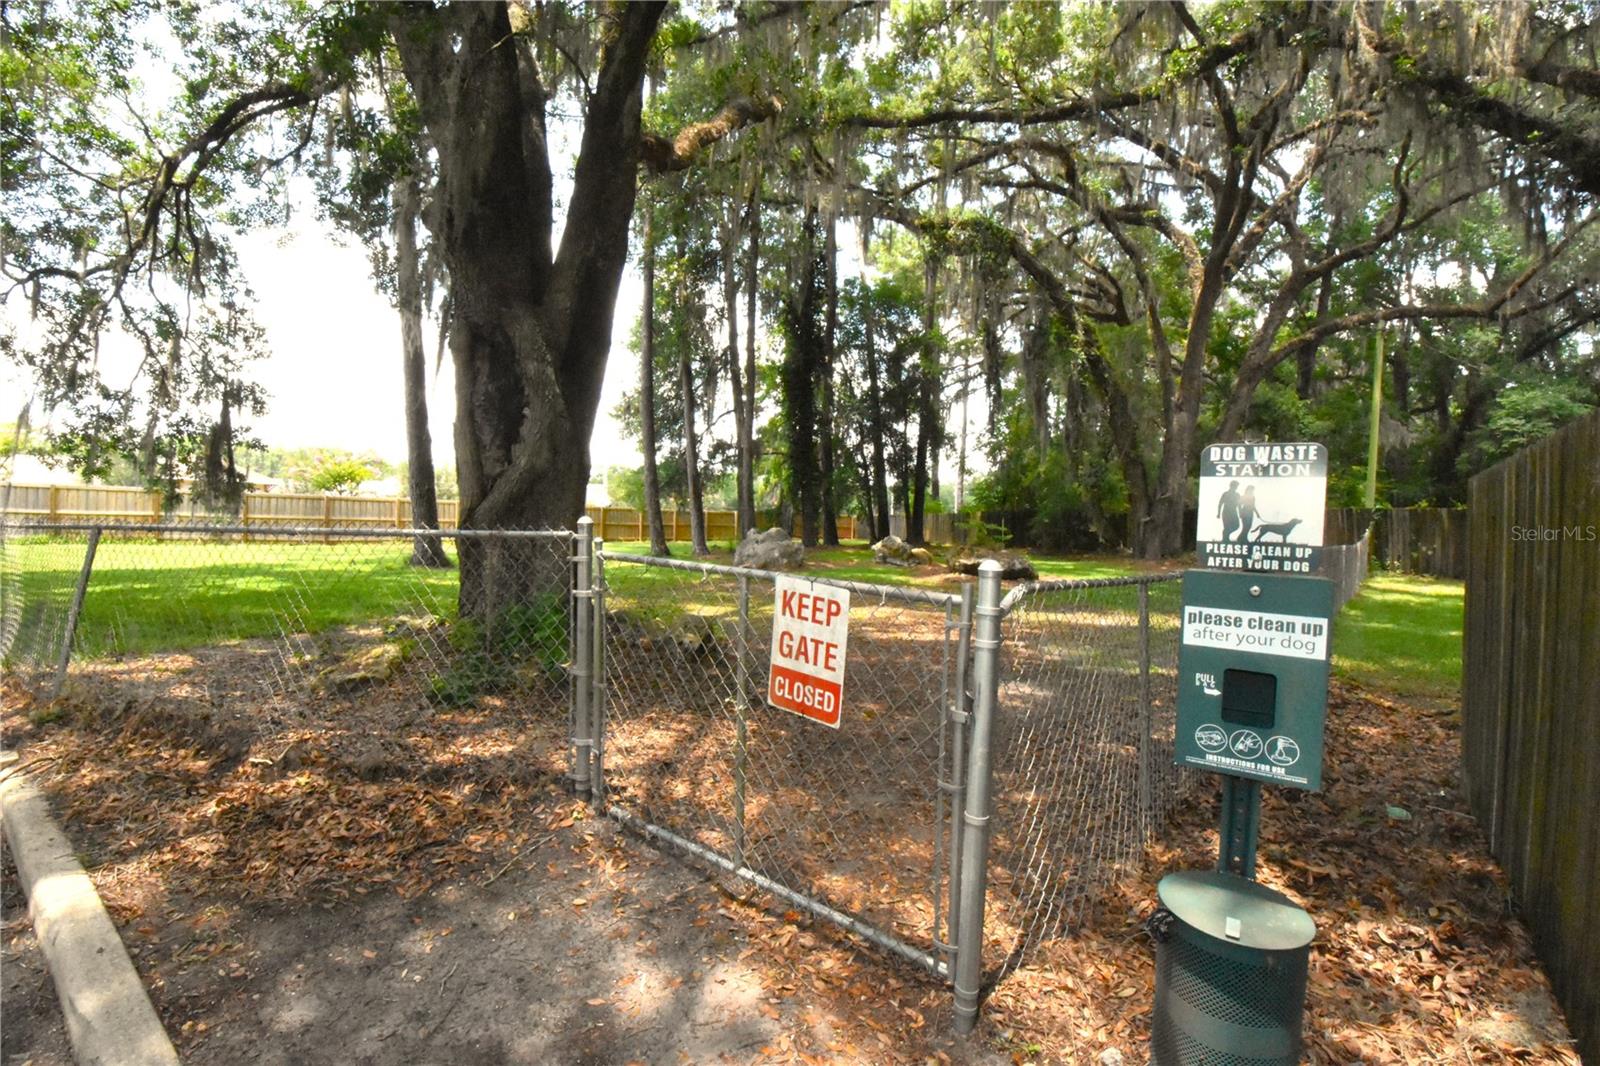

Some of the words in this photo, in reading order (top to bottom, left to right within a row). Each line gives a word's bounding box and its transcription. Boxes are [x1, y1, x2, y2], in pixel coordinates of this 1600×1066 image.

[1210, 446, 1247, 461] DOG
[1253, 446, 1318, 461] WASTE
[1206, 543, 1248, 555] PLEASE
[1252, 545, 1291, 557] CLEAN
[1295, 547, 1312, 558] UP
[1207, 556, 1242, 568] AFTER
[1247, 559, 1279, 570] YOUR
[1283, 560, 1310, 572] DOG
[781, 589, 841, 627] KEEP
[1188, 611, 1243, 628] please
[1248, 616, 1296, 633] clean
[1301, 622, 1323, 637] up
[779, 630, 838, 672] GATE
[1193, 626, 1232, 641] after
[1236, 633, 1276, 647] your
[1280, 635, 1316, 655] dog
[1195, 672, 1214, 682] PULL
[774, 676, 835, 713] CLOSED
[1206, 753, 1256, 769] INSTRUCTIONS
[1257, 763, 1271, 772] FOR
[1272, 765, 1286, 774] USE
